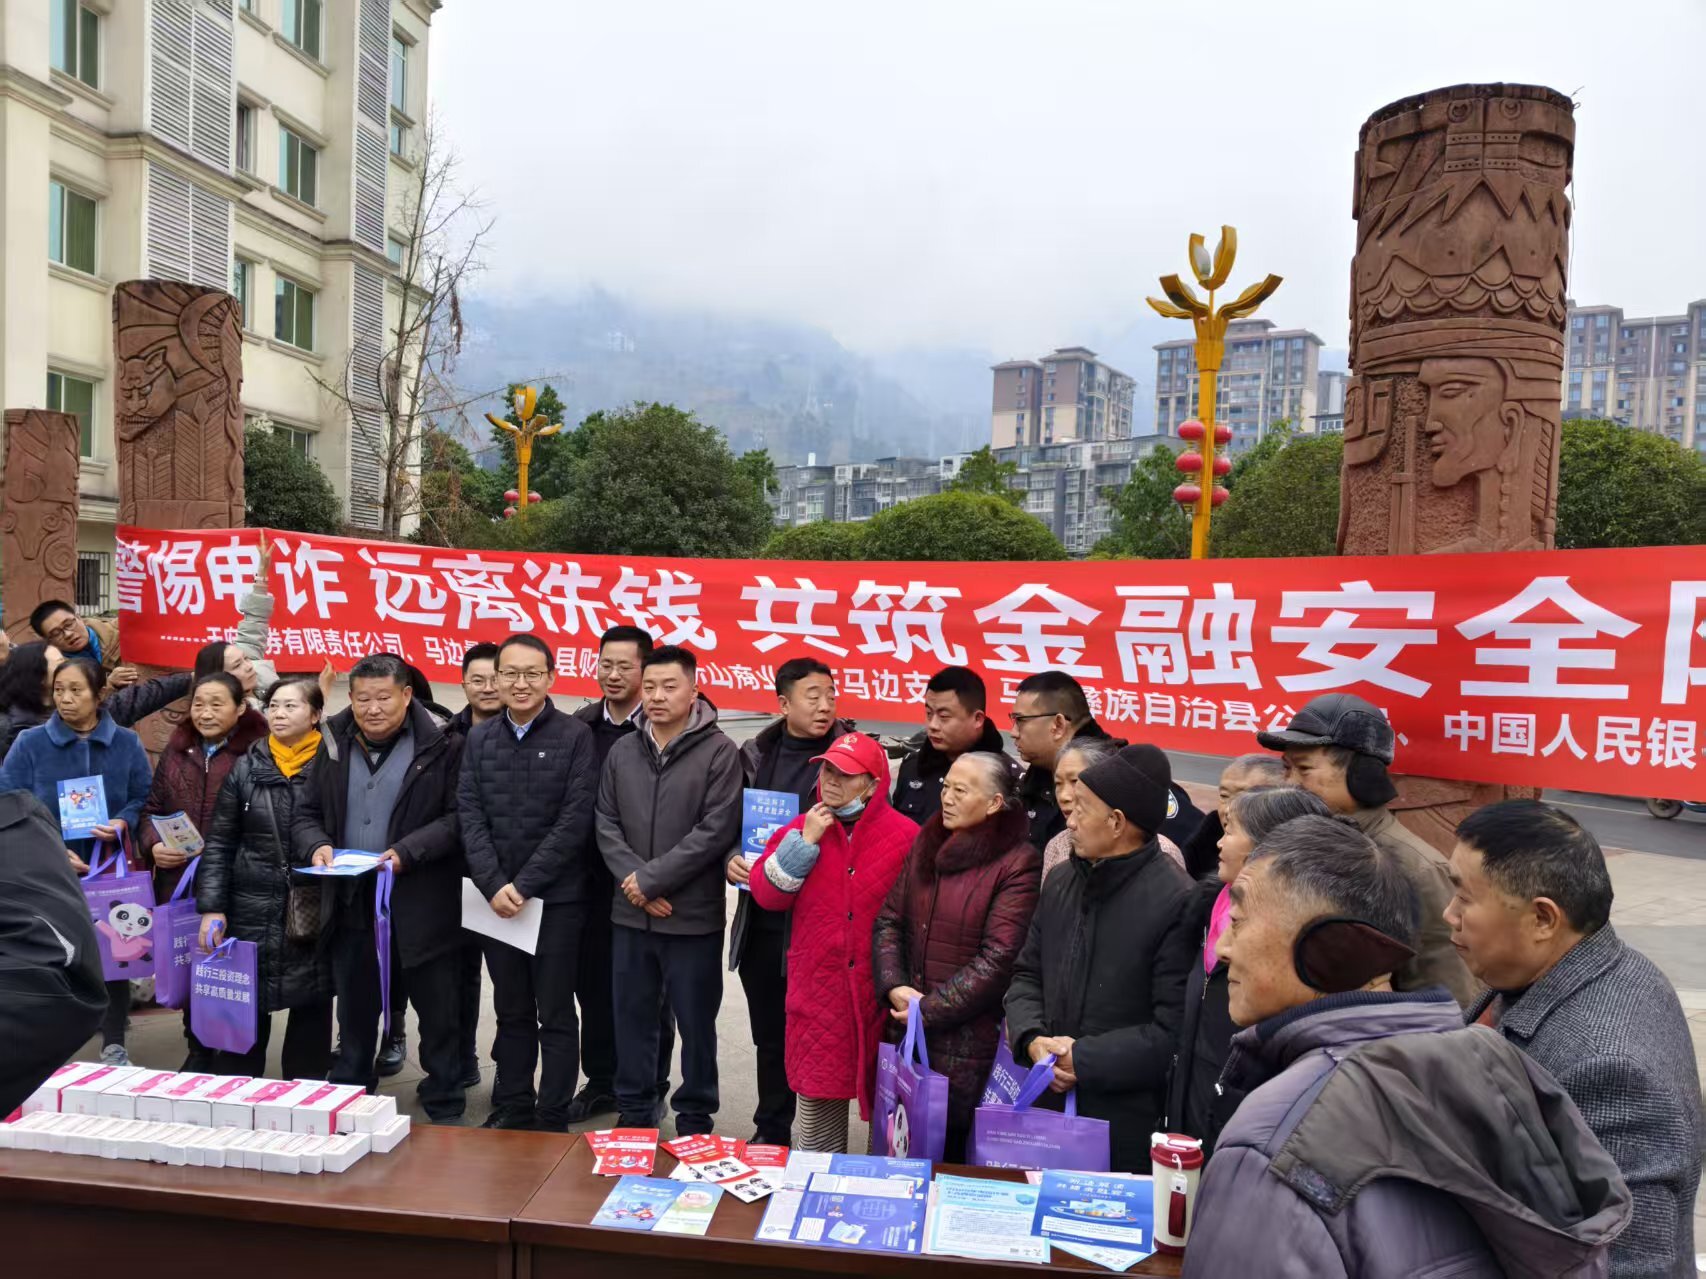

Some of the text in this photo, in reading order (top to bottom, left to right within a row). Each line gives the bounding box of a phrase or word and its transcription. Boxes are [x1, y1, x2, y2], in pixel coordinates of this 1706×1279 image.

[115, 535, 348, 619] 警惕电诈
[358, 547, 717, 651] 远离洗钱
[1443, 709, 1706, 770] 中国人民银
